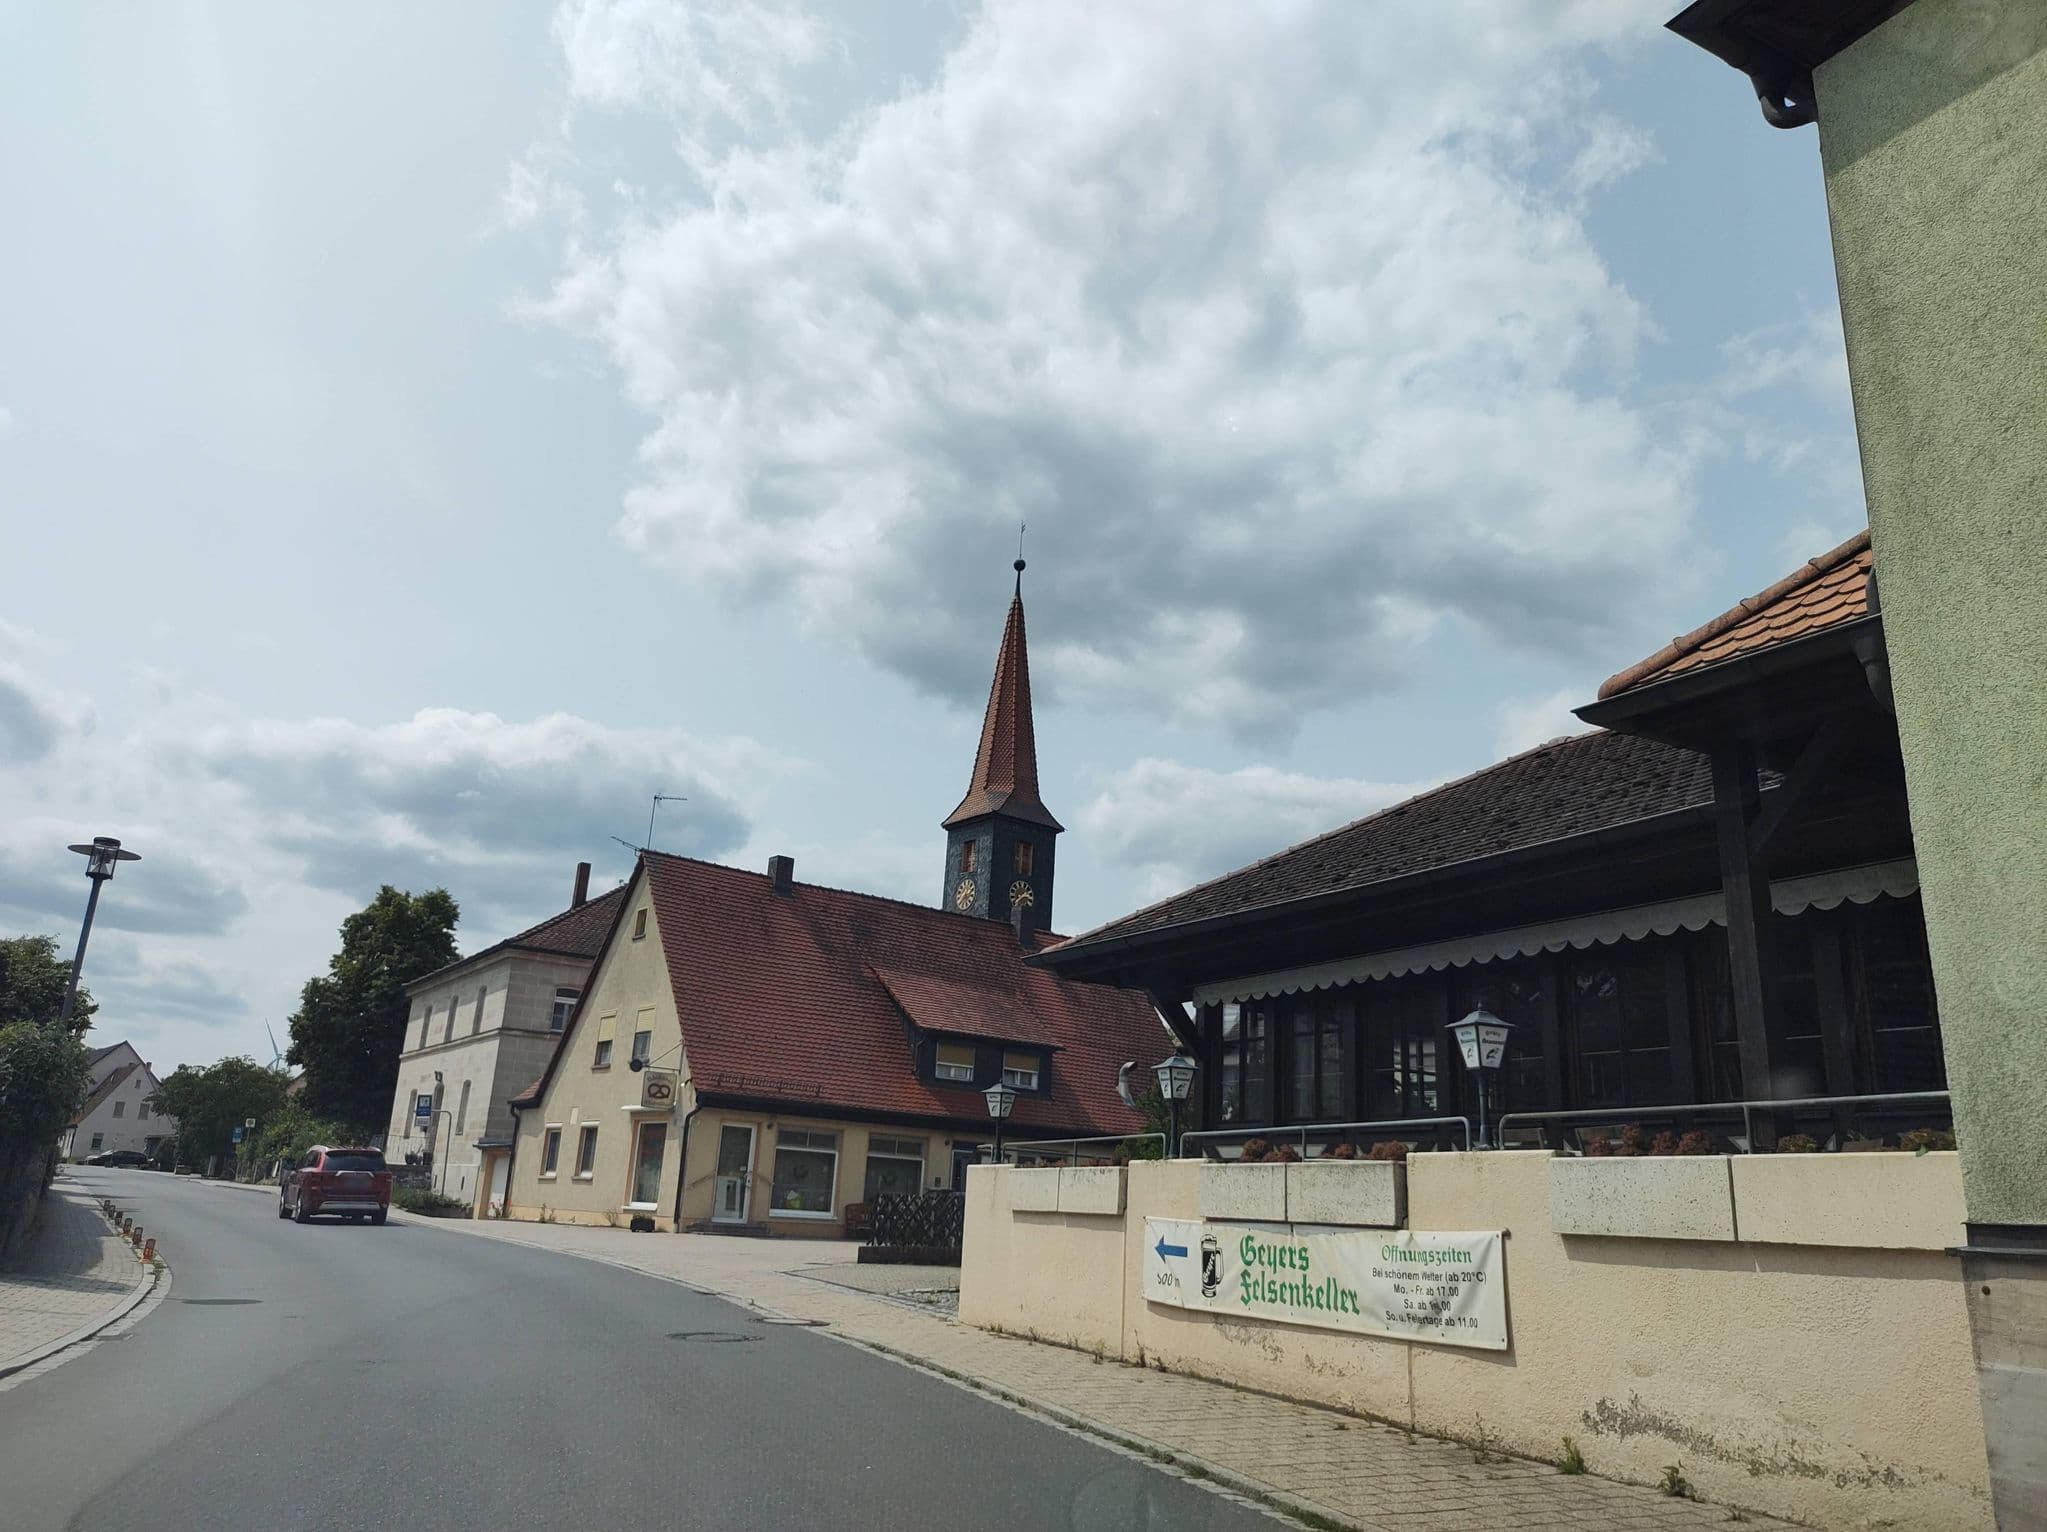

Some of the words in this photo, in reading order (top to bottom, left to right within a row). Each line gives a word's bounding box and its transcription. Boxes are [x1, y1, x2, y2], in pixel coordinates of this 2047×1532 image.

[1240, 1235, 1309, 1274] Geyers
[1372, 1267, 1383, 1278] Bei
[1384, 1268, 1420, 1281] schönem
[1445, 1271, 1459, 1284] (ab
[1461, 1271, 1487, 1284] 20°C)
[1240, 1269, 1360, 1316] Felsenkeller
[1393, 1283, 1408, 1295] Mo.
[1415, 1285, 1424, 1296] Fr.
[1425, 1286, 1434, 1296] ab
[1436, 1286, 1459, 1297] 17.00
[1403, 1299, 1415, 1310] Sa.
[1417, 1300, 1427, 1310] ab
[1385, 1310, 1398, 1321] So.
[1399, 1313, 1406, 1323] u.
[1406, 1312, 1443, 1328] Feiertage
[1444, 1316, 1456, 1326] ab
[1458, 1317, 1478, 1329] 11.00
